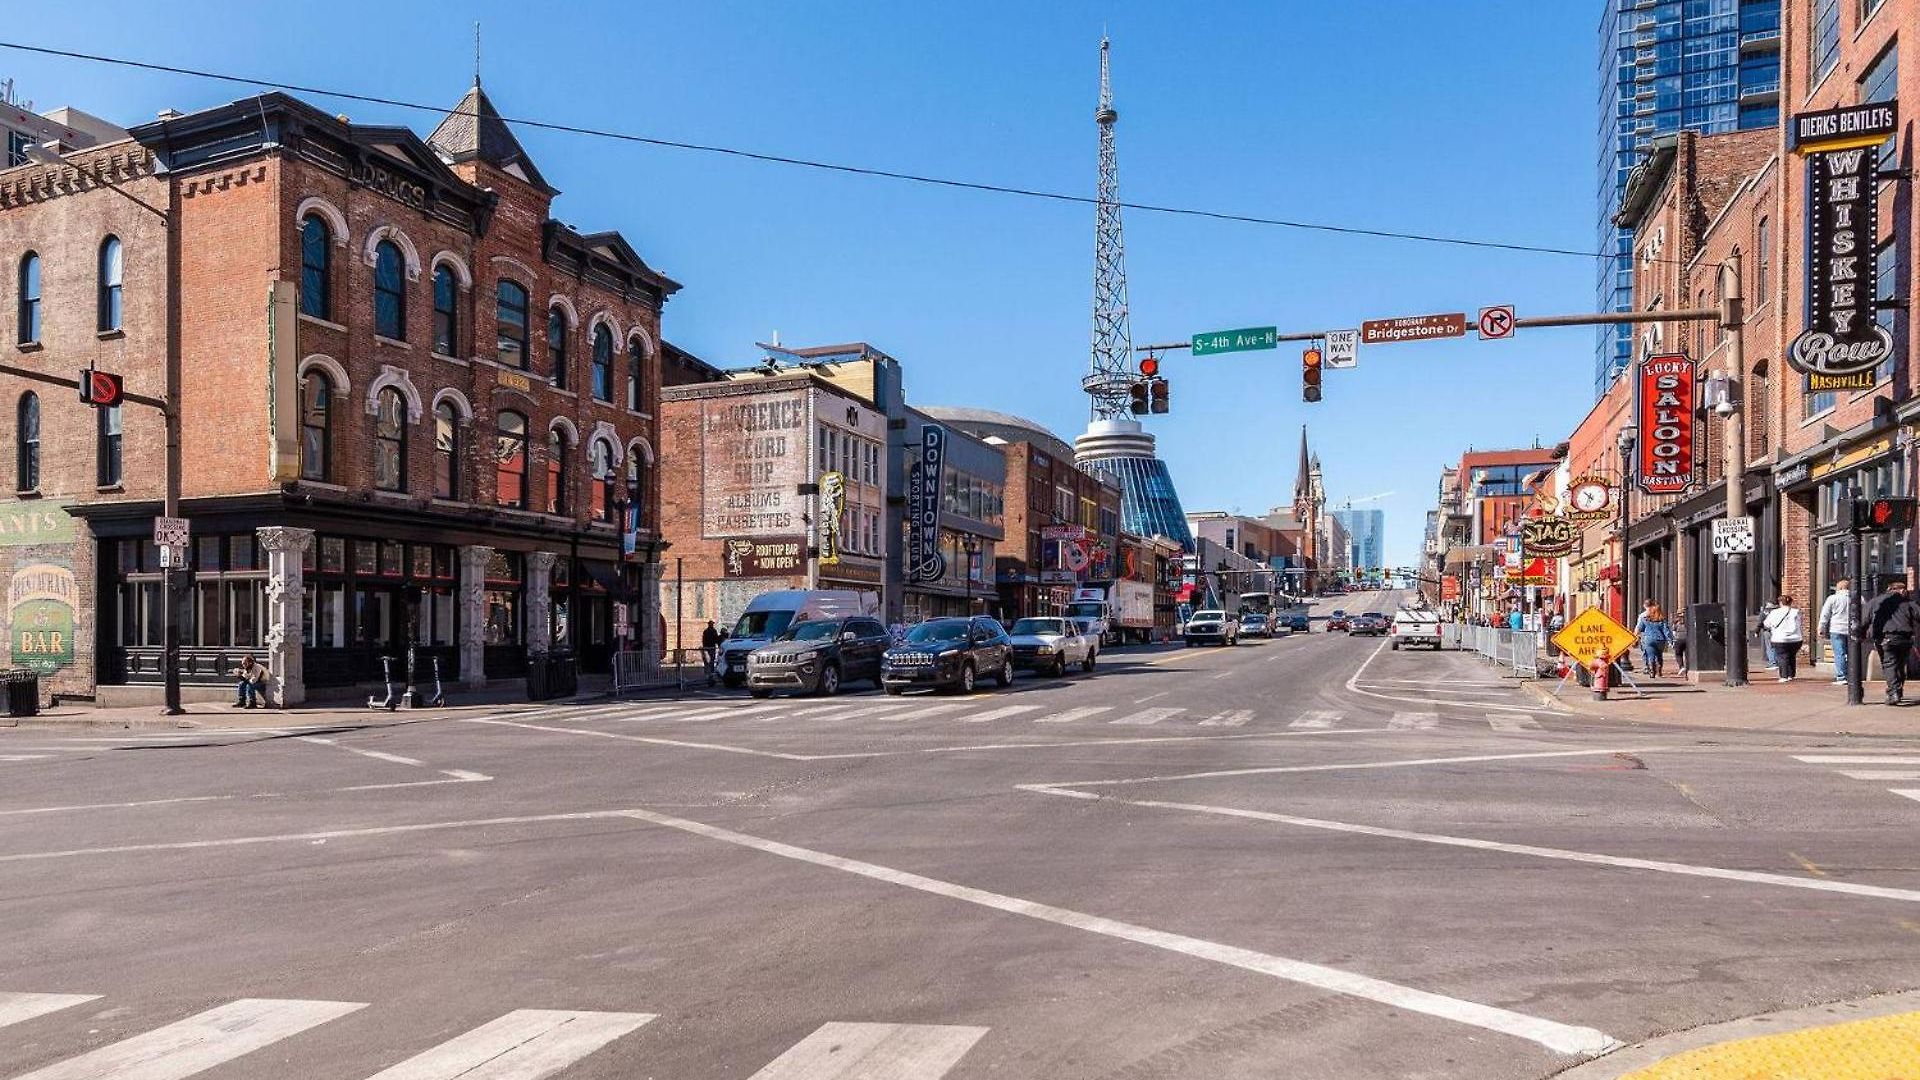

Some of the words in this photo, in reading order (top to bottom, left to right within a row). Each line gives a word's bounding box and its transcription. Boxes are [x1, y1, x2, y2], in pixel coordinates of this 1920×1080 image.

[1800, 114, 1837, 138] DIERKS
[1825, 149, 1865, 333] WHISKEY
[1331, 333, 1353, 343] ONE
[1367, 324, 1444, 340] Bridgestone
[1446, 324, 1459, 334] Dr
[1330, 343, 1353, 353] WAY
[1803, 332, 1885, 373] Row
[1645, 361, 1690, 376] LUCKY
[1810, 370, 1874, 390] NASHVILLE
[1653, 374, 1681, 475] SALOON
[911, 471, 921, 527] SPORTING
[923, 432, 938, 555] DOWNTOWN
[156, 530, 169, 542] OK
[1521, 519, 1580, 543] STAGE
[1714, 535, 1730, 549] OK
[776, 556, 794, 569] OPEN
[1580, 624, 1605, 633] LANE
[21, 631, 64, 654] BAR
[1574, 635, 1613, 645] CLOSED
